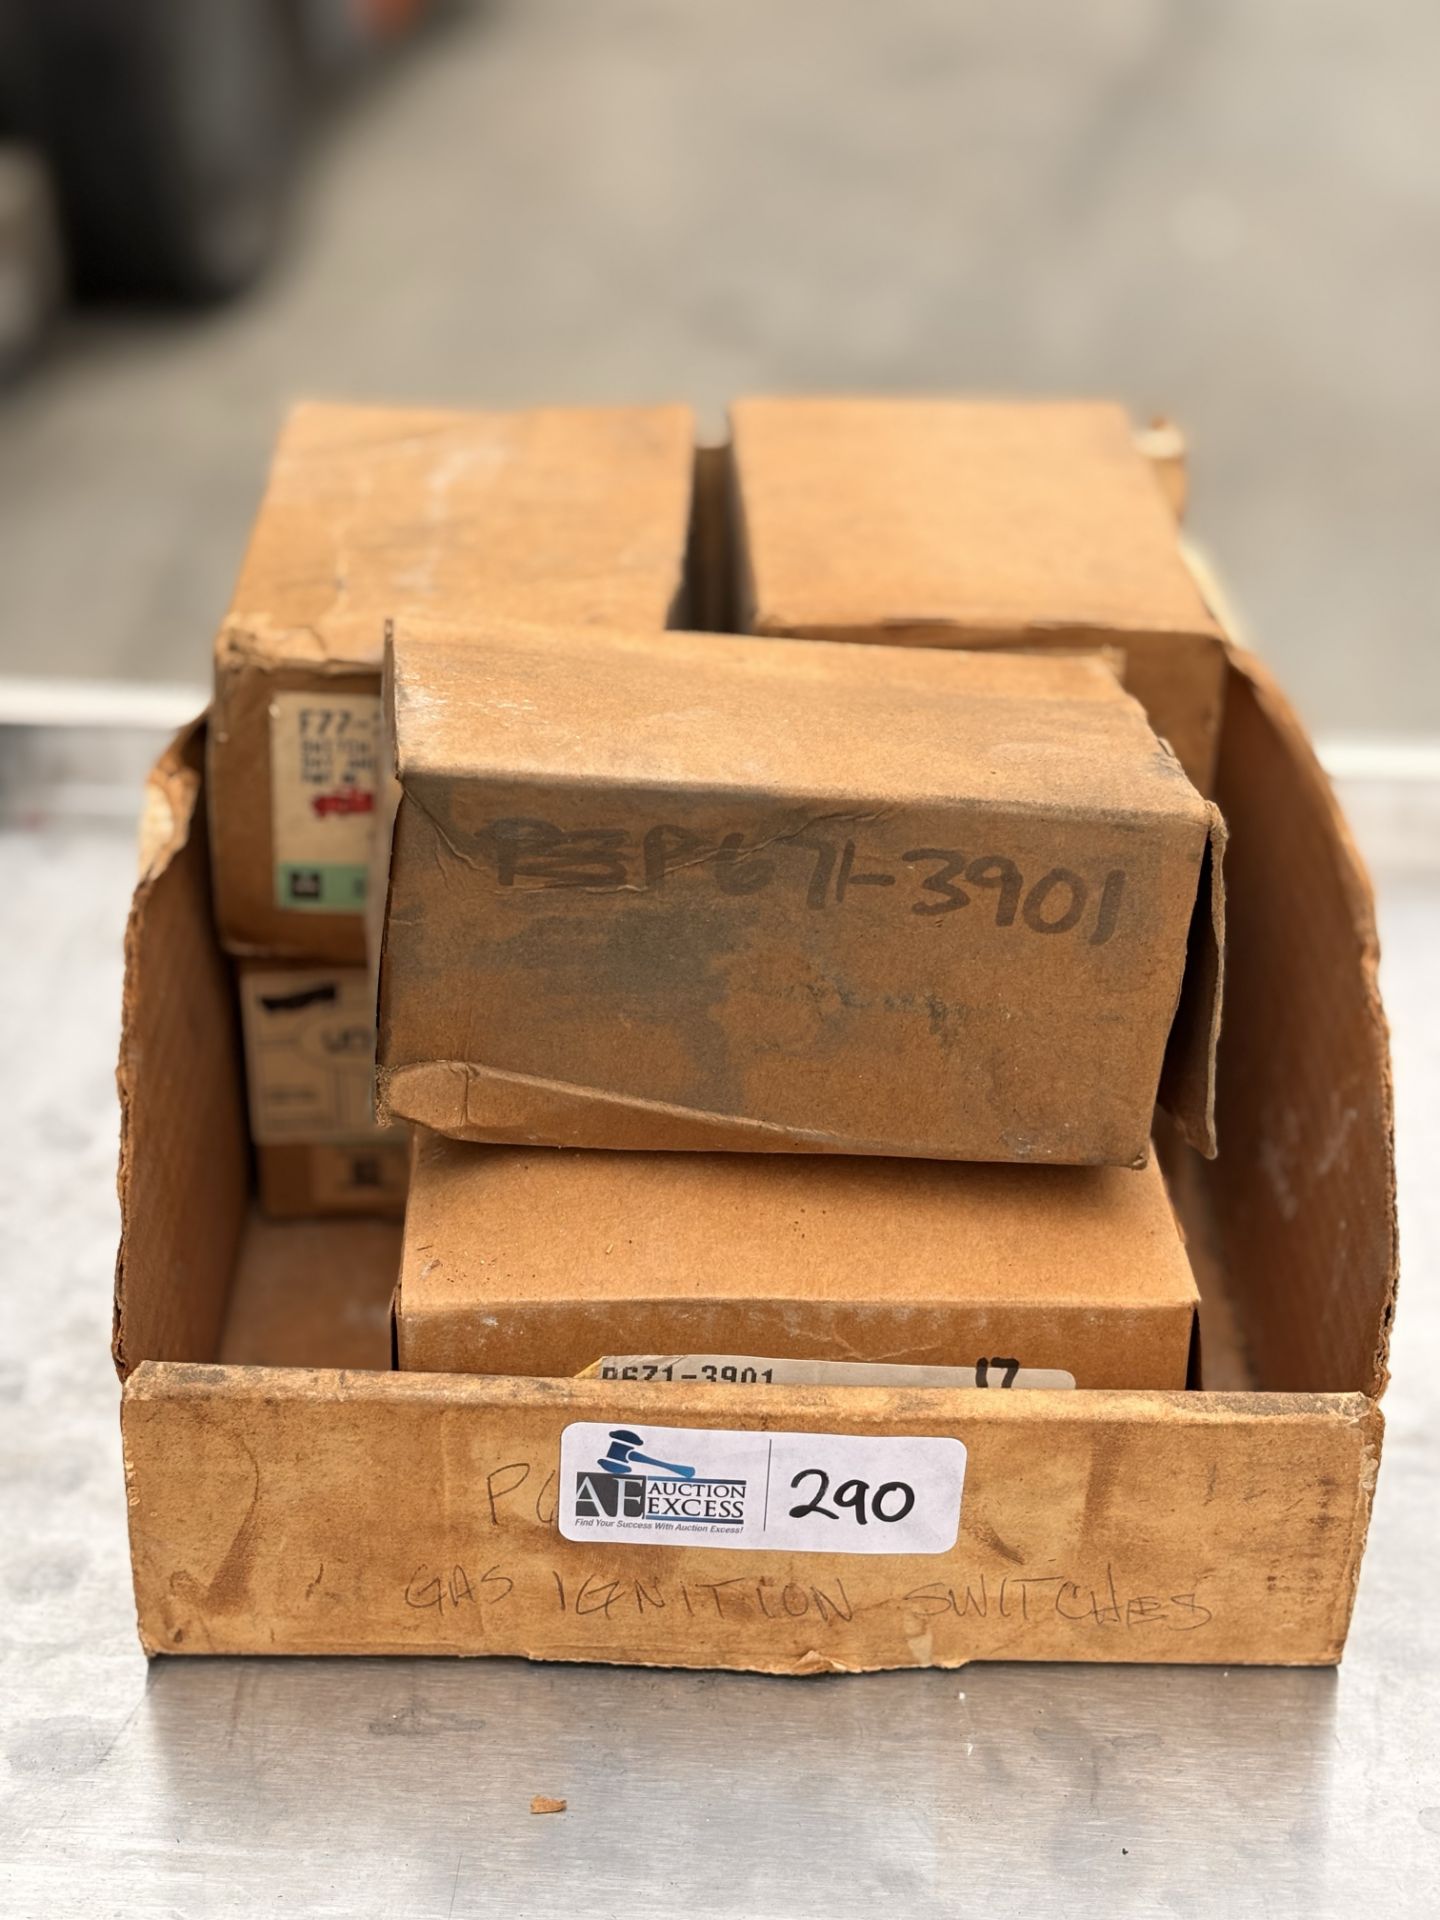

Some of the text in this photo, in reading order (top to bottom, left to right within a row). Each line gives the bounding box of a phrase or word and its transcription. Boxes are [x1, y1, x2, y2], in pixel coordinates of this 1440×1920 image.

[648, 1481, 747, 1500] AUCTION
[788, 1468, 916, 1526] 290
[647, 1496, 745, 1519] EXCESS
[575, 1517, 744, 1534] Find Your Success With Auction Excess!
[404, 1562, 1213, 1632] GAS IGNITION SWITCHES
